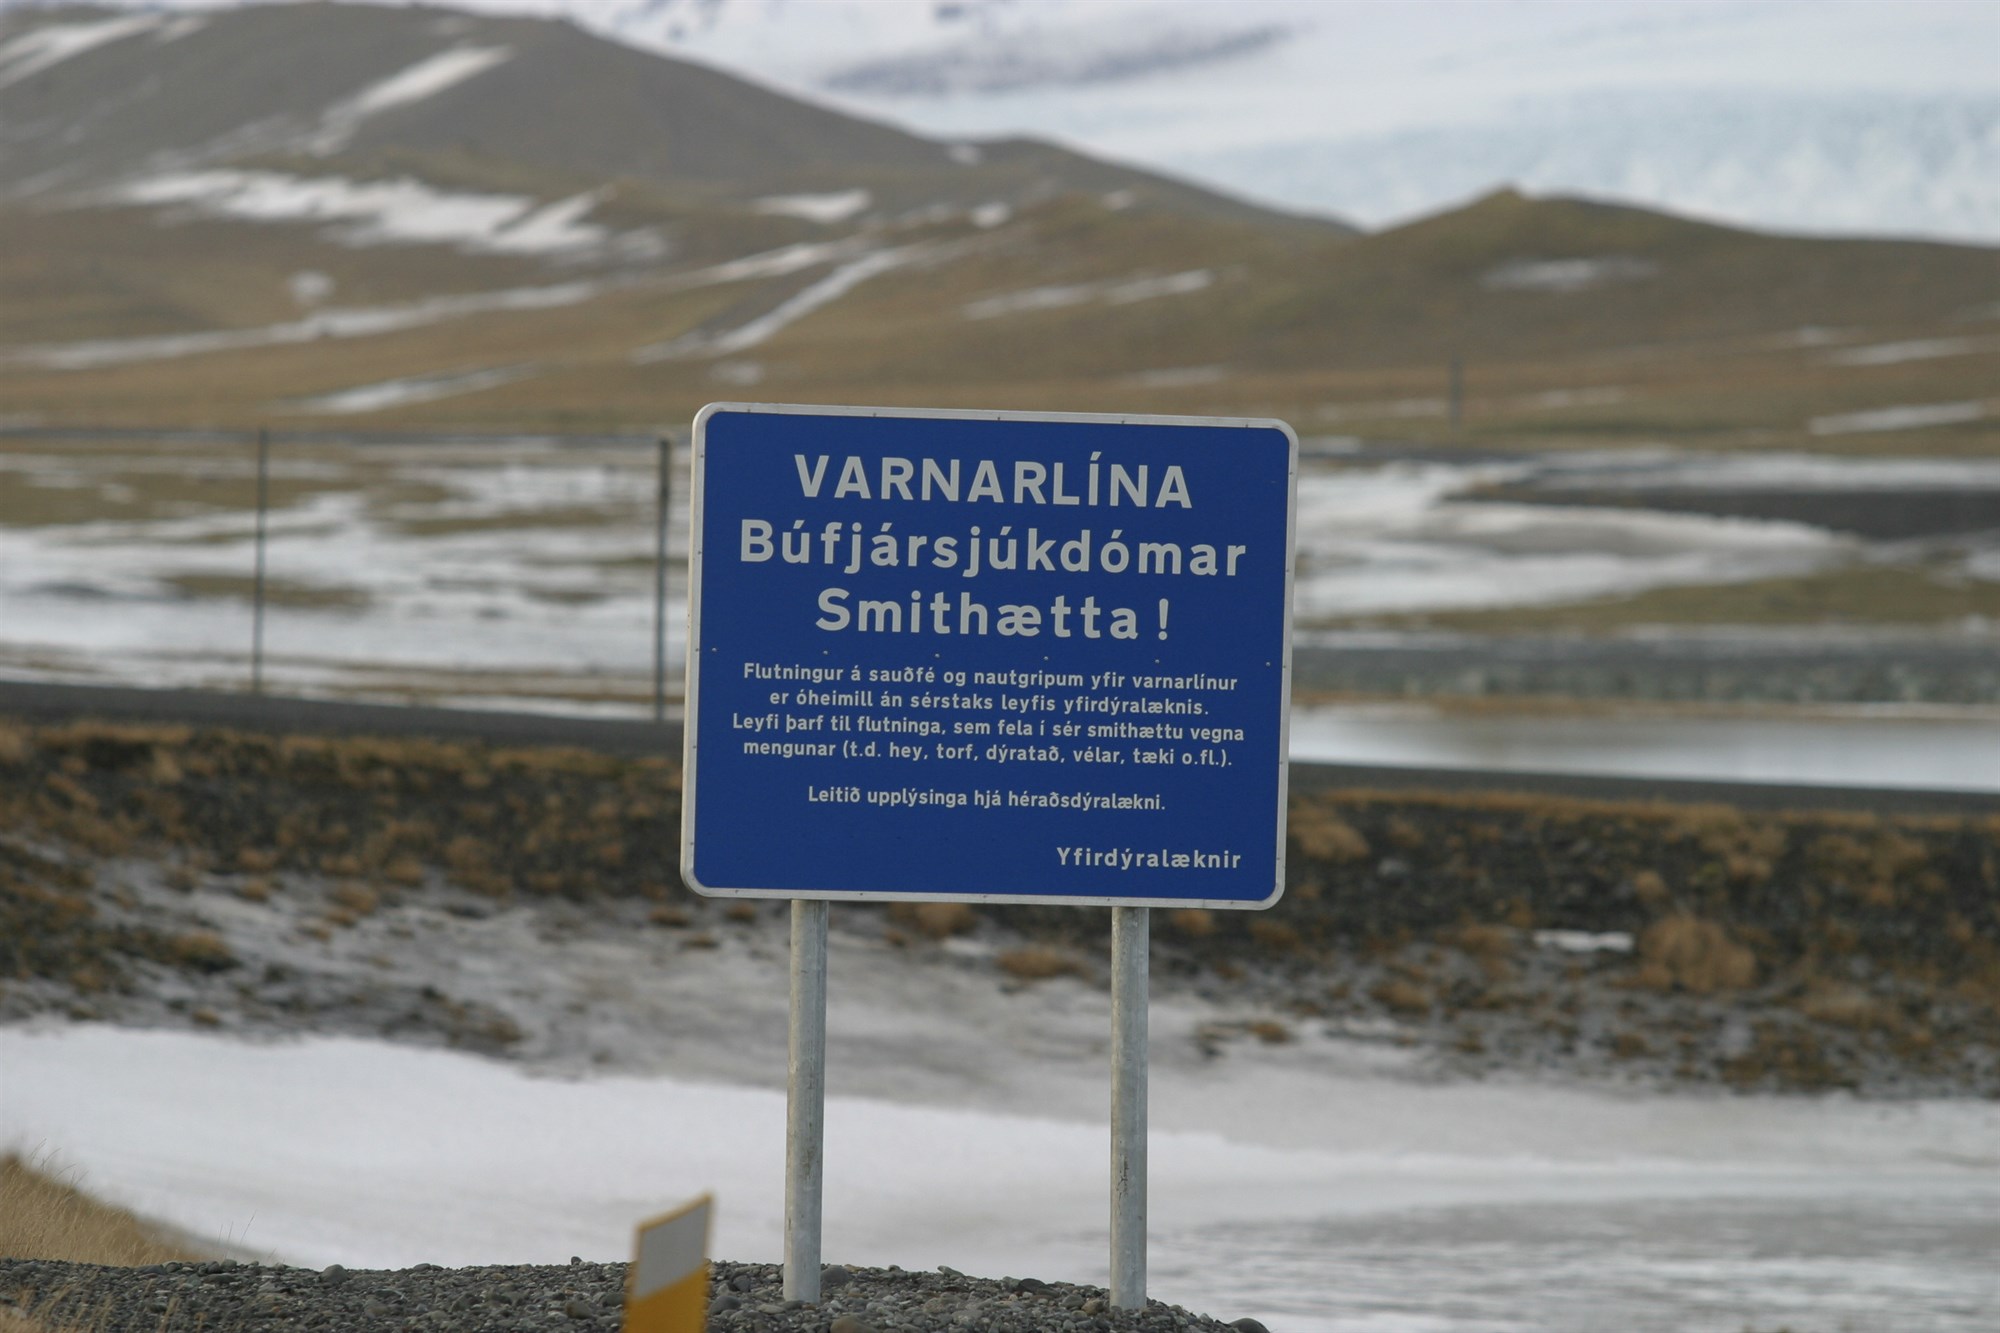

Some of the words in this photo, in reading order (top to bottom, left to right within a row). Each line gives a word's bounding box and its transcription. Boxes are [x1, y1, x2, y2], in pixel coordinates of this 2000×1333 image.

[794, 451, 1192, 508] VARNARLÍNA
[741, 519, 1246, 577] Búfjársjúkdómar
[816, 588, 1138, 639] Smithætta
[1158, 598, 1169, 640] !
[744, 662, 844, 683] Flutningur
[851, 665, 861, 681] á
[869, 667, 935, 683] sauðfé
[943, 671, 966, 687] og
[974, 670, 1083, 689] nautgripum
[1091, 672, 1125, 690] yfir
[1132, 673, 1237, 690] varnarlínur
[770, 692, 789, 704] er
[796, 689, 873, 707] óheimill
[880, 691, 902, 707] án
[910, 692, 993, 709] sérstaks
[1002, 694, 1055, 713] leyfis
[1064, 696, 1208, 716] yfirdýralæknis.
[733, 713, 779, 732] Leyfi
[786, 714, 824, 733] þarf
[830, 715, 851, 731] til
[857, 716, 946, 736] flutninga,
[954, 722, 990, 734] sem
[998, 719, 1033, 736] fela
[1040, 720, 1045, 736] í
[1052, 720, 1081, 736] sér
[1087, 722, 1183, 739] smithættu
[1190, 728, 1244, 743] vegna
[744, 742, 836, 758] mengunar
[843, 740, 881, 758] (t.d.
[890, 742, 928, 761] hey,
[936, 743, 978, 761] torf,
[986, 744, 1065, 763] dýratað,
[1073, 746, 1124, 764] vélar,
[1133, 748, 1174, 764] tæki
[1182, 749, 1232, 767] o.fl.).
[809, 786, 860, 803] Leitið
[868, 788, 967, 808] upplýsinga
[974, 790, 1001, 809] hjá
[1008, 790, 1165, 811] héraðsdýralækni.
[1057, 847, 1241, 870] Yfirdýralæknir
